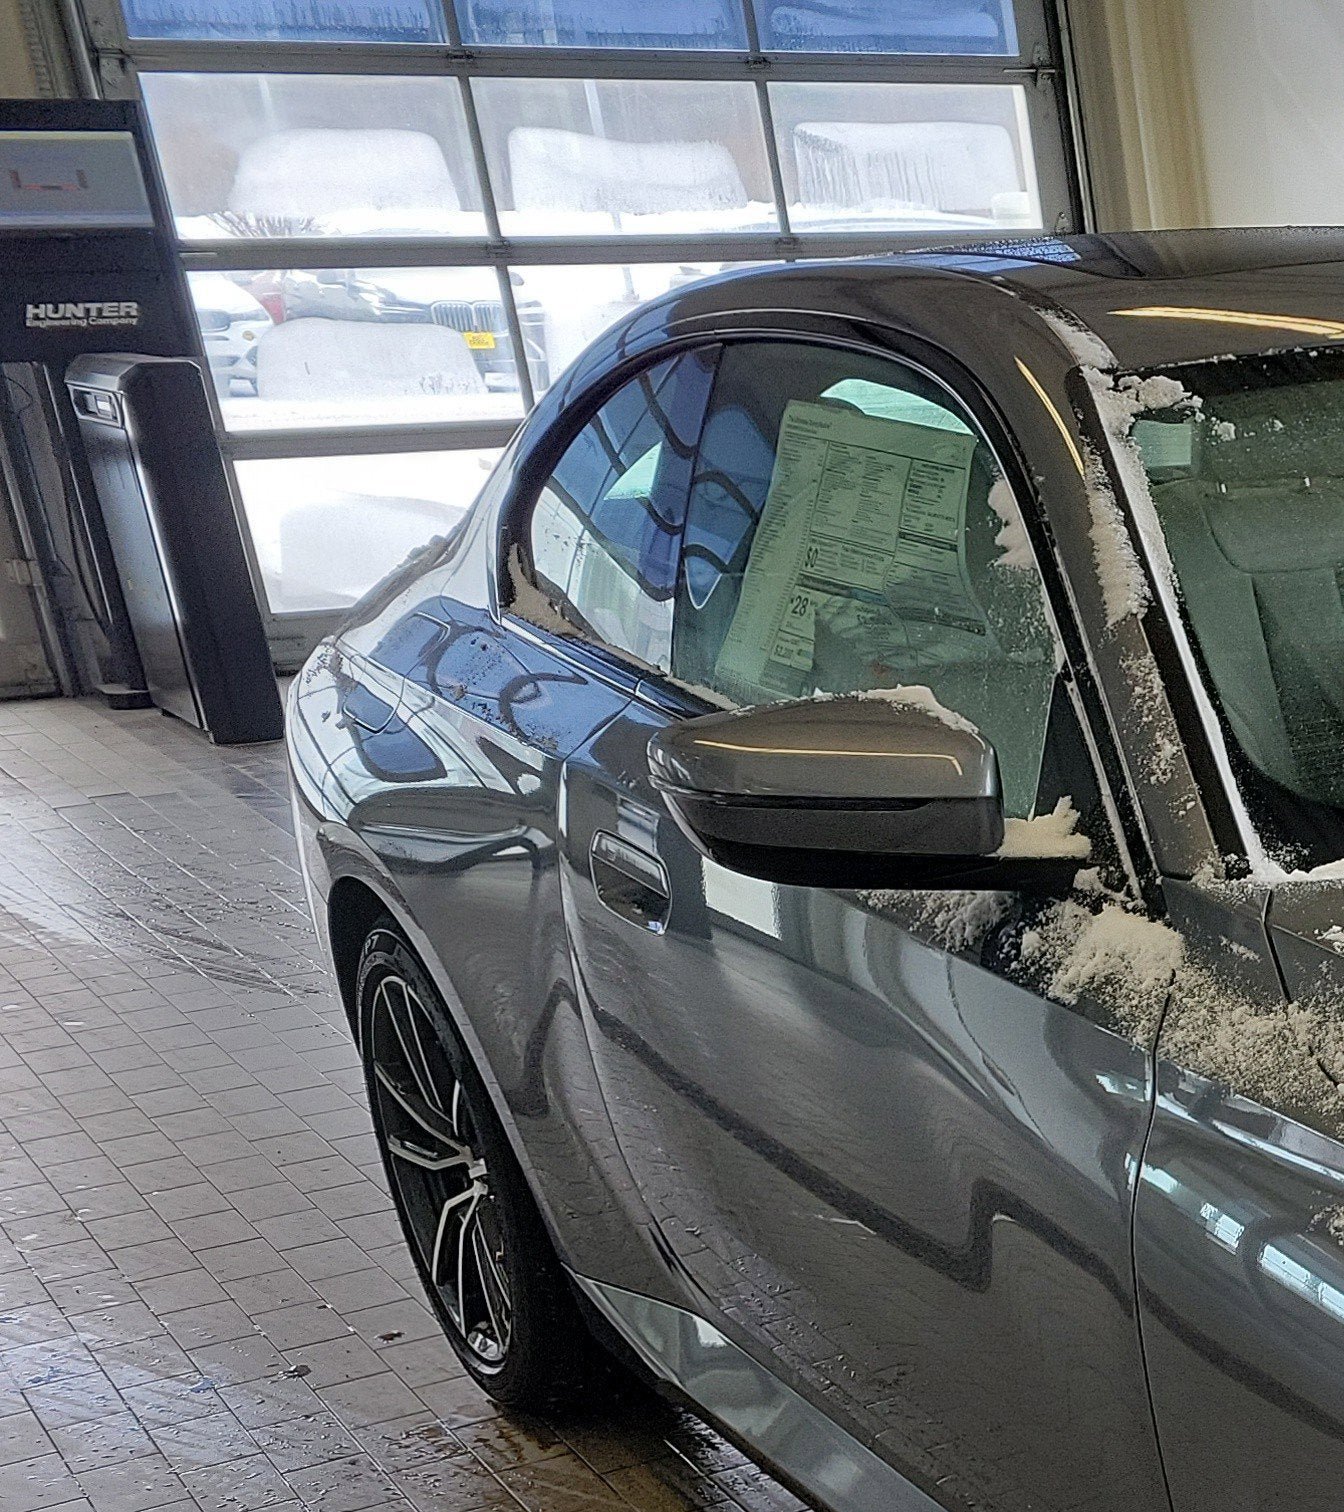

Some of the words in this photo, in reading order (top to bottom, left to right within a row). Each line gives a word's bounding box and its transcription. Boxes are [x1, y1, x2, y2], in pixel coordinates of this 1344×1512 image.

[25, 302, 139, 319] HUNTER
[88, 316, 138, 326] Company
[791, 595, 809, 617] 28
